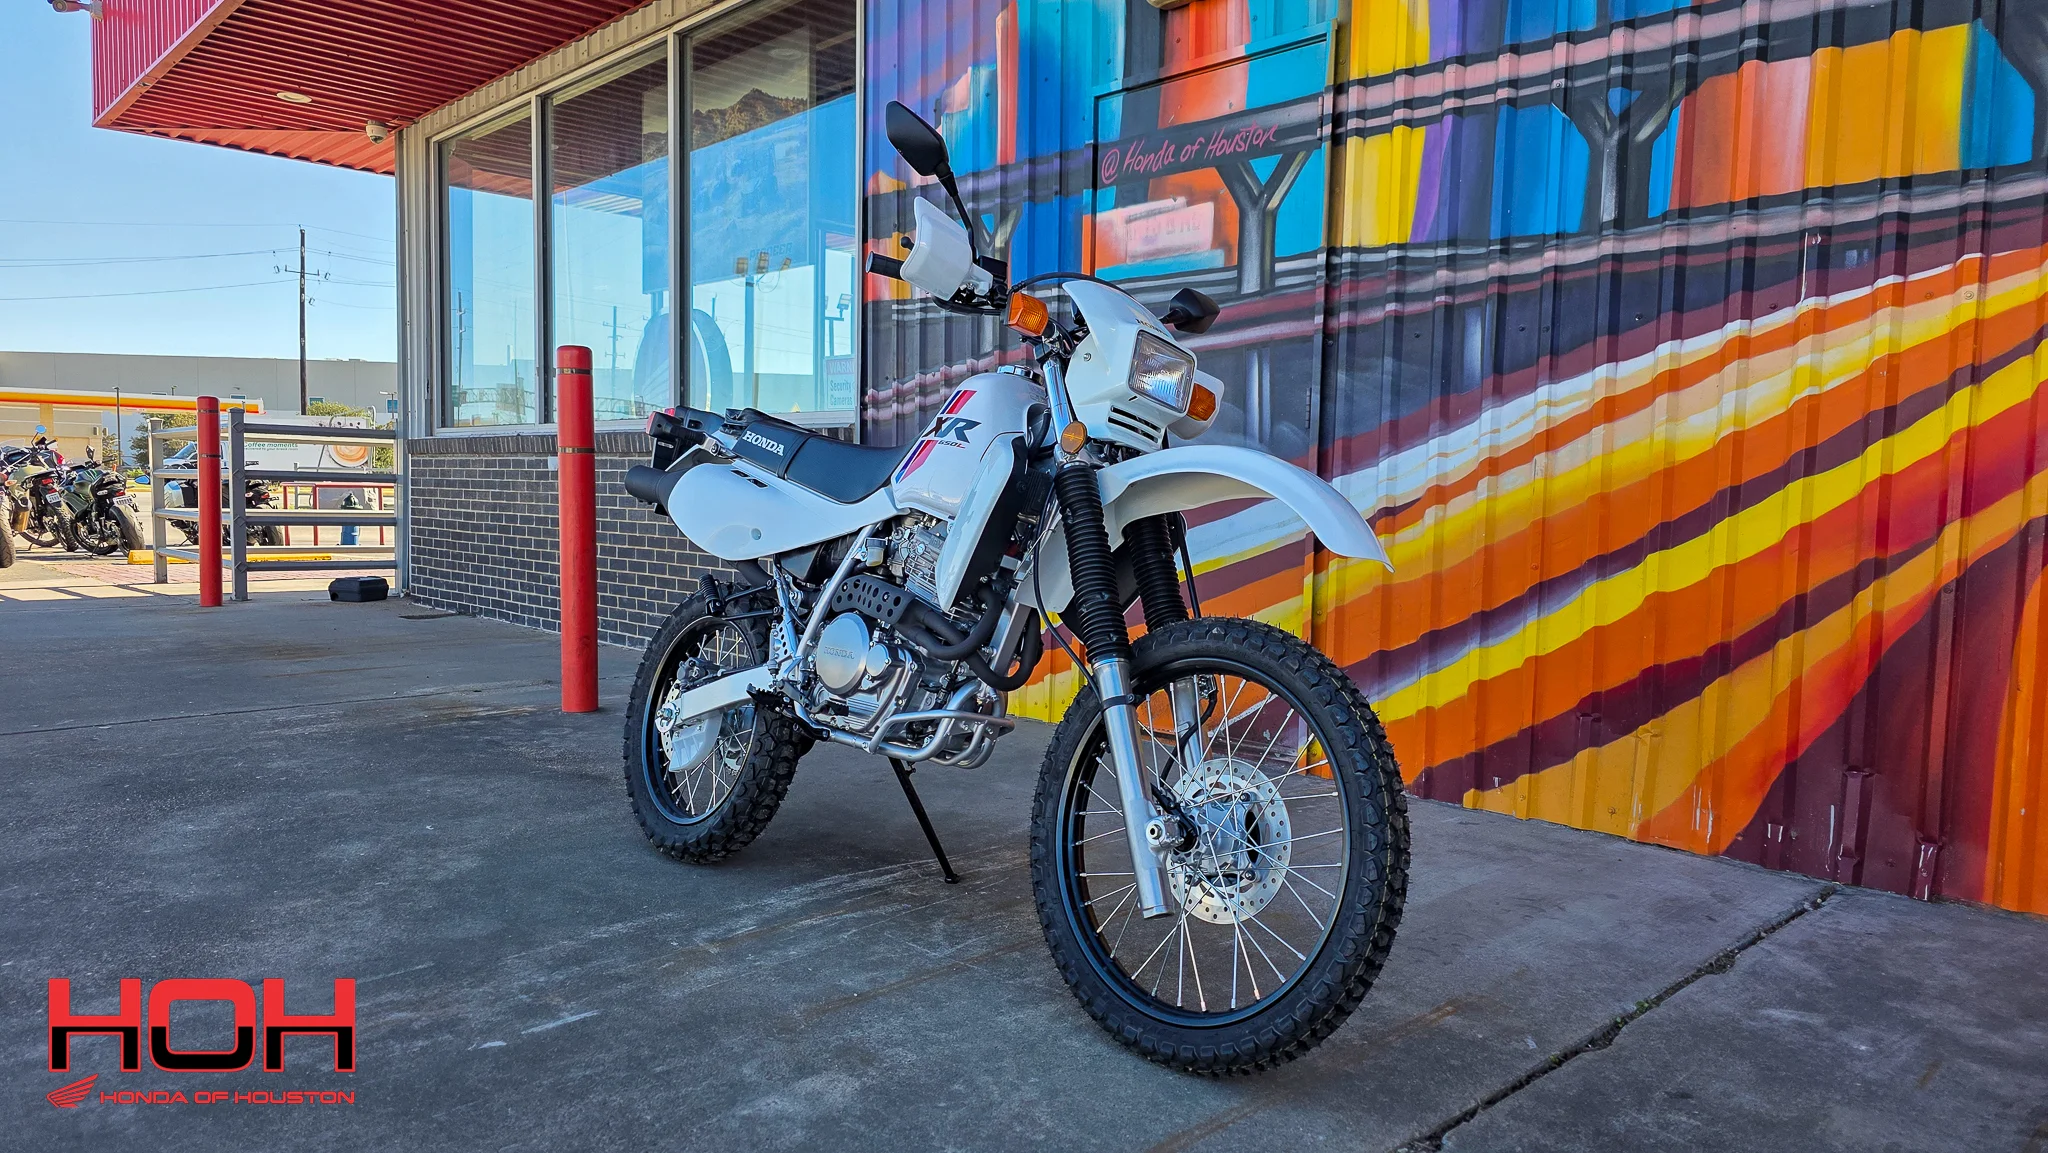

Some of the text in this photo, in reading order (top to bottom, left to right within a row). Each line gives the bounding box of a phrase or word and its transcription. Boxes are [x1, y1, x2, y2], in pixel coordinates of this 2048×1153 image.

[1101, 120, 1279, 184] @ Honda of Houston
[830, 380, 852, 393] Security
[830, 394, 853, 406] Cameras
[922, 416, 982, 443] XR
[742, 431, 785, 456] HONDA
[938, 440, 966, 449] 650L
[823, 646, 855, 660] HONDA
